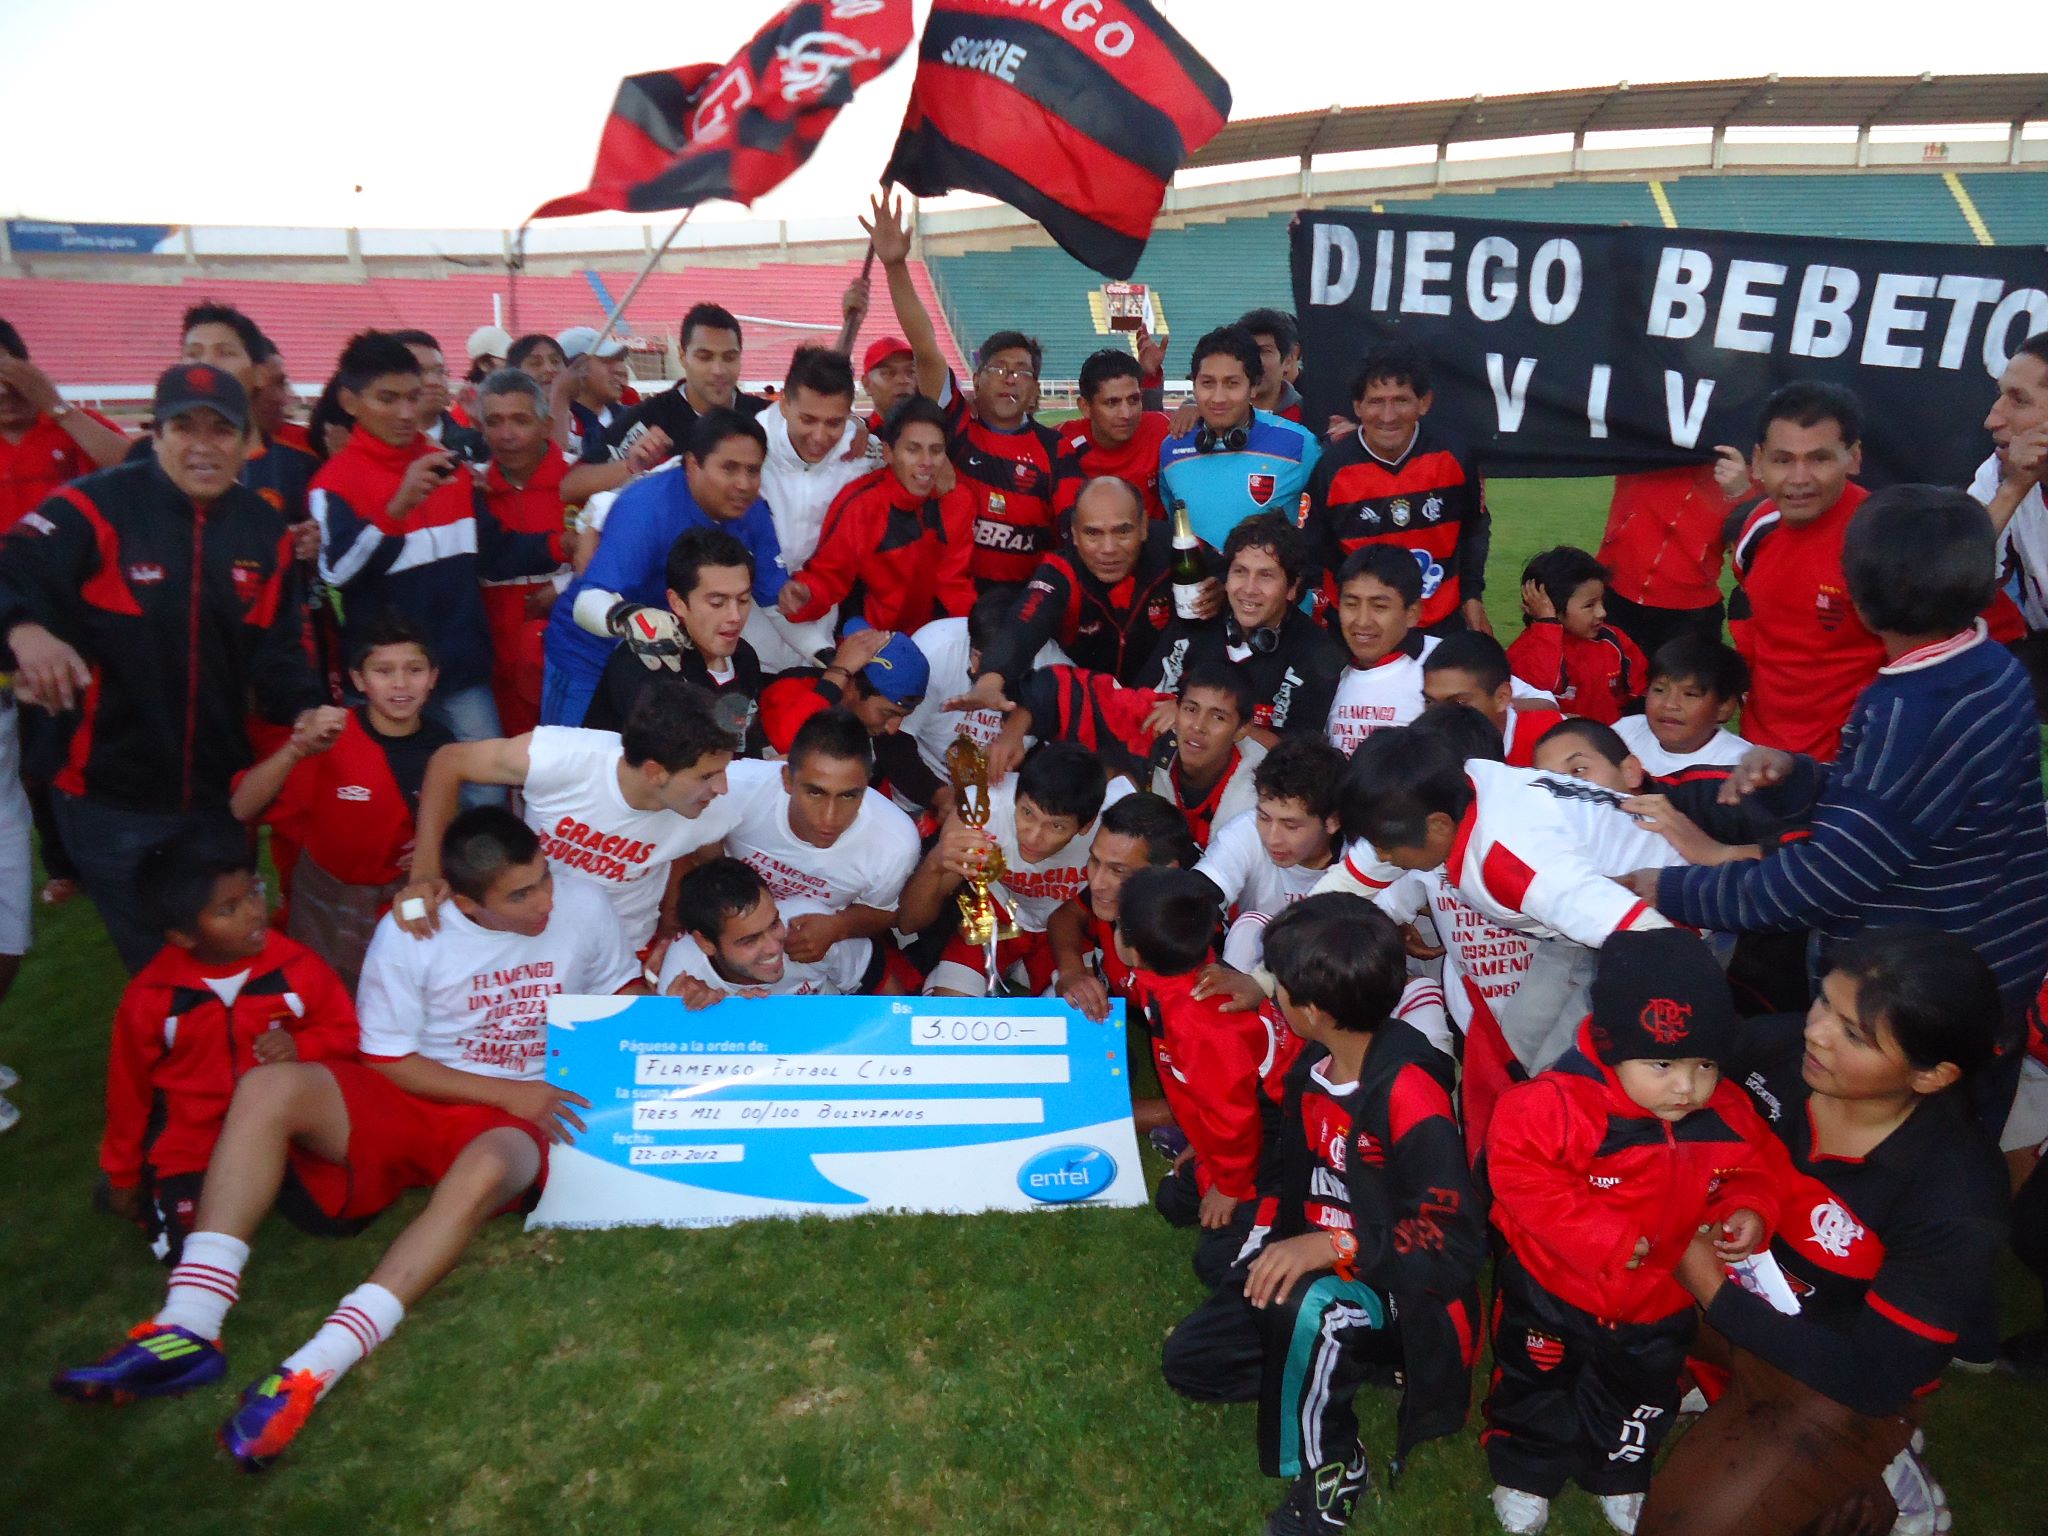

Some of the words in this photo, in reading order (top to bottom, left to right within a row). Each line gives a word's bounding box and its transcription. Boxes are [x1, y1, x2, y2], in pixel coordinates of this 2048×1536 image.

[942, 35, 1027, 83] SUCRE
[1310, 223, 1583, 325] DIEGO
[1338, 705, 1396, 721] FLAMENGO
[1332, 723, 1353, 736] UNA
[555, 815, 657, 864] GRACIAS
[752, 850, 828, 888] FLAMENGO
[1452, 930, 1475, 943] UN
[1461, 940, 1528, 960] CORAZON
[473, 961, 554, 991] FLAMENGO
[469, 994, 504, 1011] UNA
[508, 983, 563, 1000] NUEVA
[892, 1002, 913, 1015] Bs:
[619, 1039, 677, 1054] Páguese
[680, 1043, 689, 1052] a
[691, 1041, 704, 1052] la
[707, 1039, 745, 1052] orden
[748, 1039, 769, 1052] de:
[645, 1058, 755, 1077] FLAMENGO
[772, 1057, 839, 1077] FUTBOL
[616, 1087, 630, 1099] la
[637, 1107, 679, 1121] TRES
[691, 1107, 722, 1121] MIL
[741, 1101, 800, 1125] 00/100
[817, 1103, 924, 1121] BOLIVIANOS
[613, 1132, 655, 1146] fecha:
[634, 1148, 718, 1161] 22-07-2012
[1030, 1167, 1090, 1187] entel
